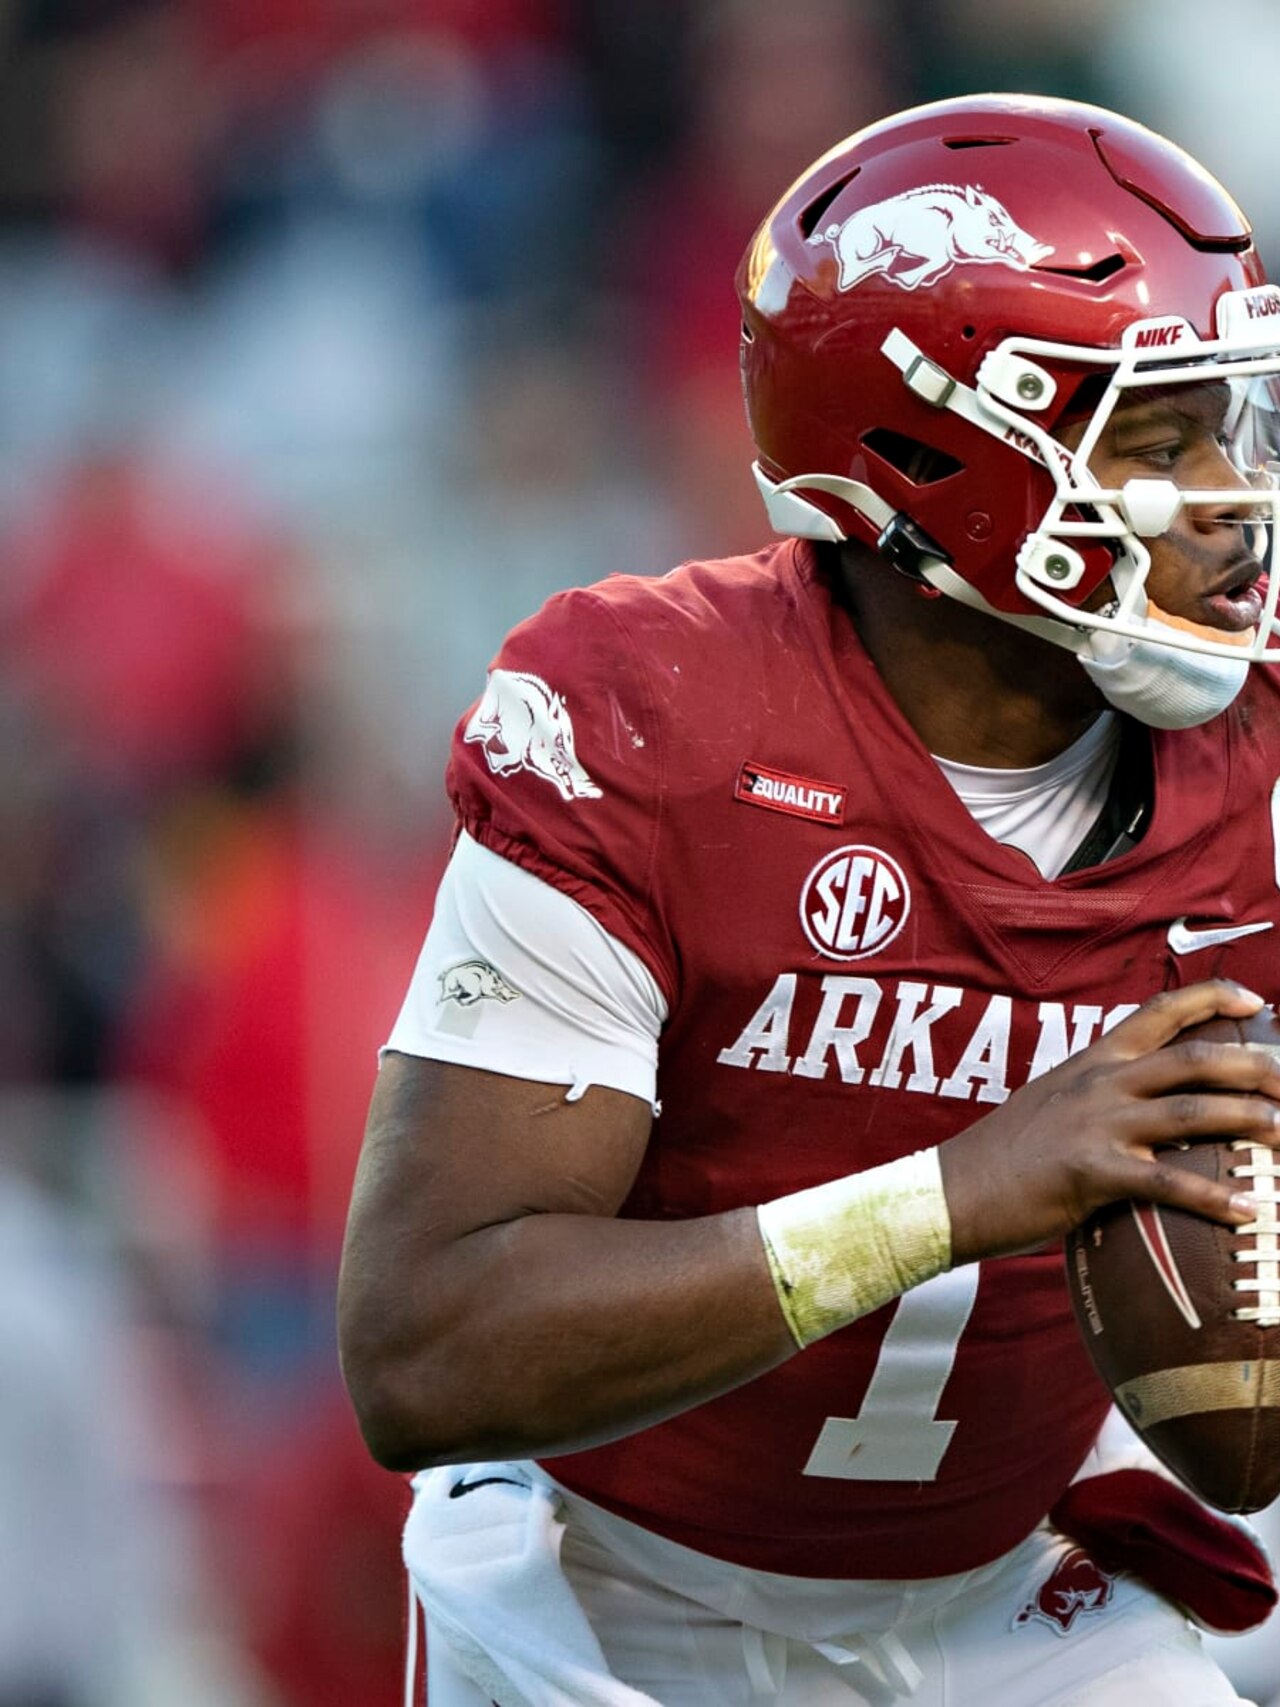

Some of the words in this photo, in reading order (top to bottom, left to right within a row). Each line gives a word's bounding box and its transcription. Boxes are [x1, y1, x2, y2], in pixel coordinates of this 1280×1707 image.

[752, 775, 842, 815] EQUALITY
[810, 856, 900, 951] SEC
[716, 973, 1141, 1105] ARKAN
